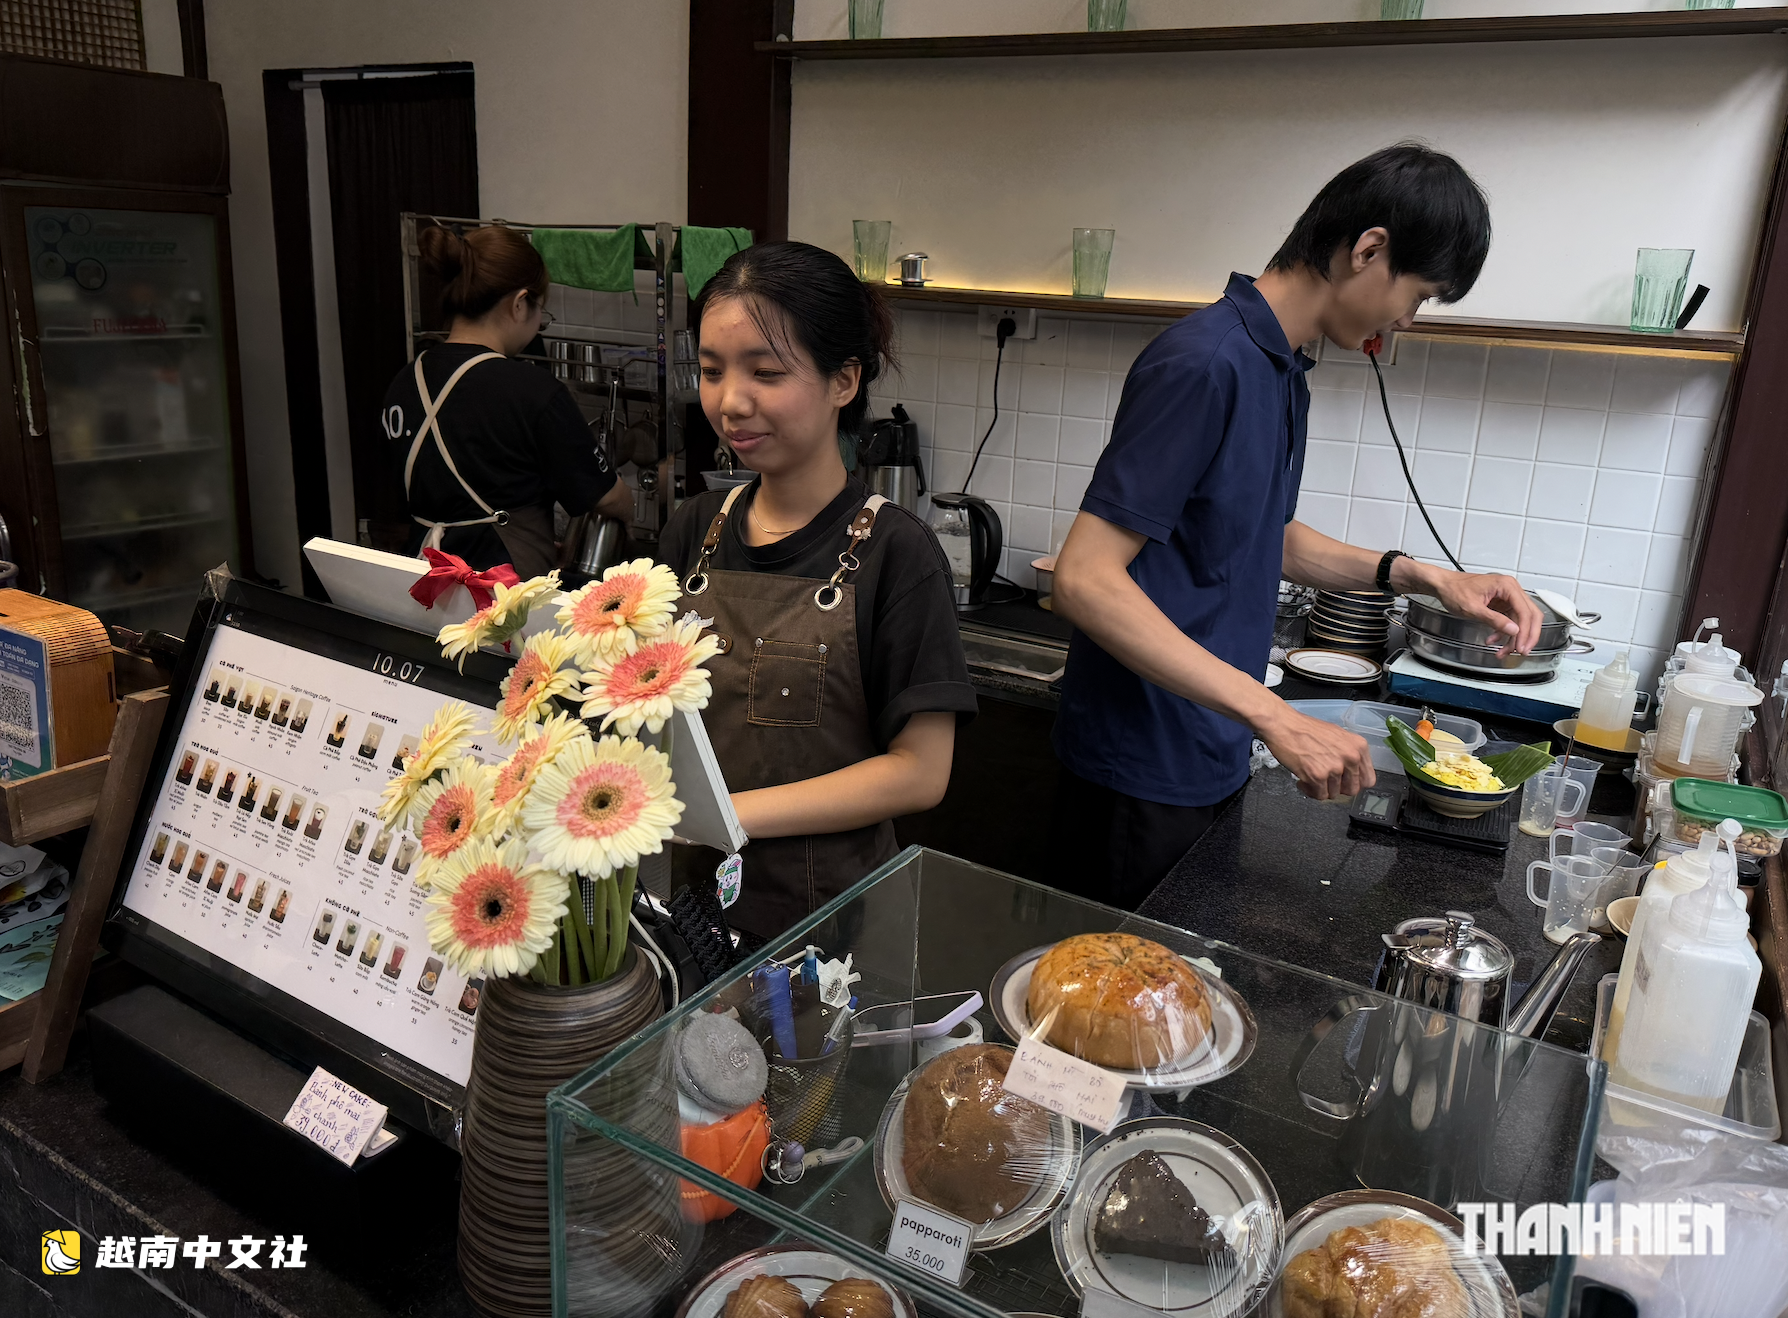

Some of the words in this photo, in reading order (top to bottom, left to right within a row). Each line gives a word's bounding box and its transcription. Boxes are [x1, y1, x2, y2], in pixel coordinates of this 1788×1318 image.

[372, 652, 425, 683] 10.07
[386, 926, 409, 941] Non-Coffee
[309, 1081, 328, 1102] Bánh
[332, 1080, 349, 1094] NEW
[349, 1090, 368, 1106] CAKE
[314, 1112, 338, 1134] chanh
[900, 1217, 962, 1248] papparoti
[905, 1246, 944, 1272] 35.000
